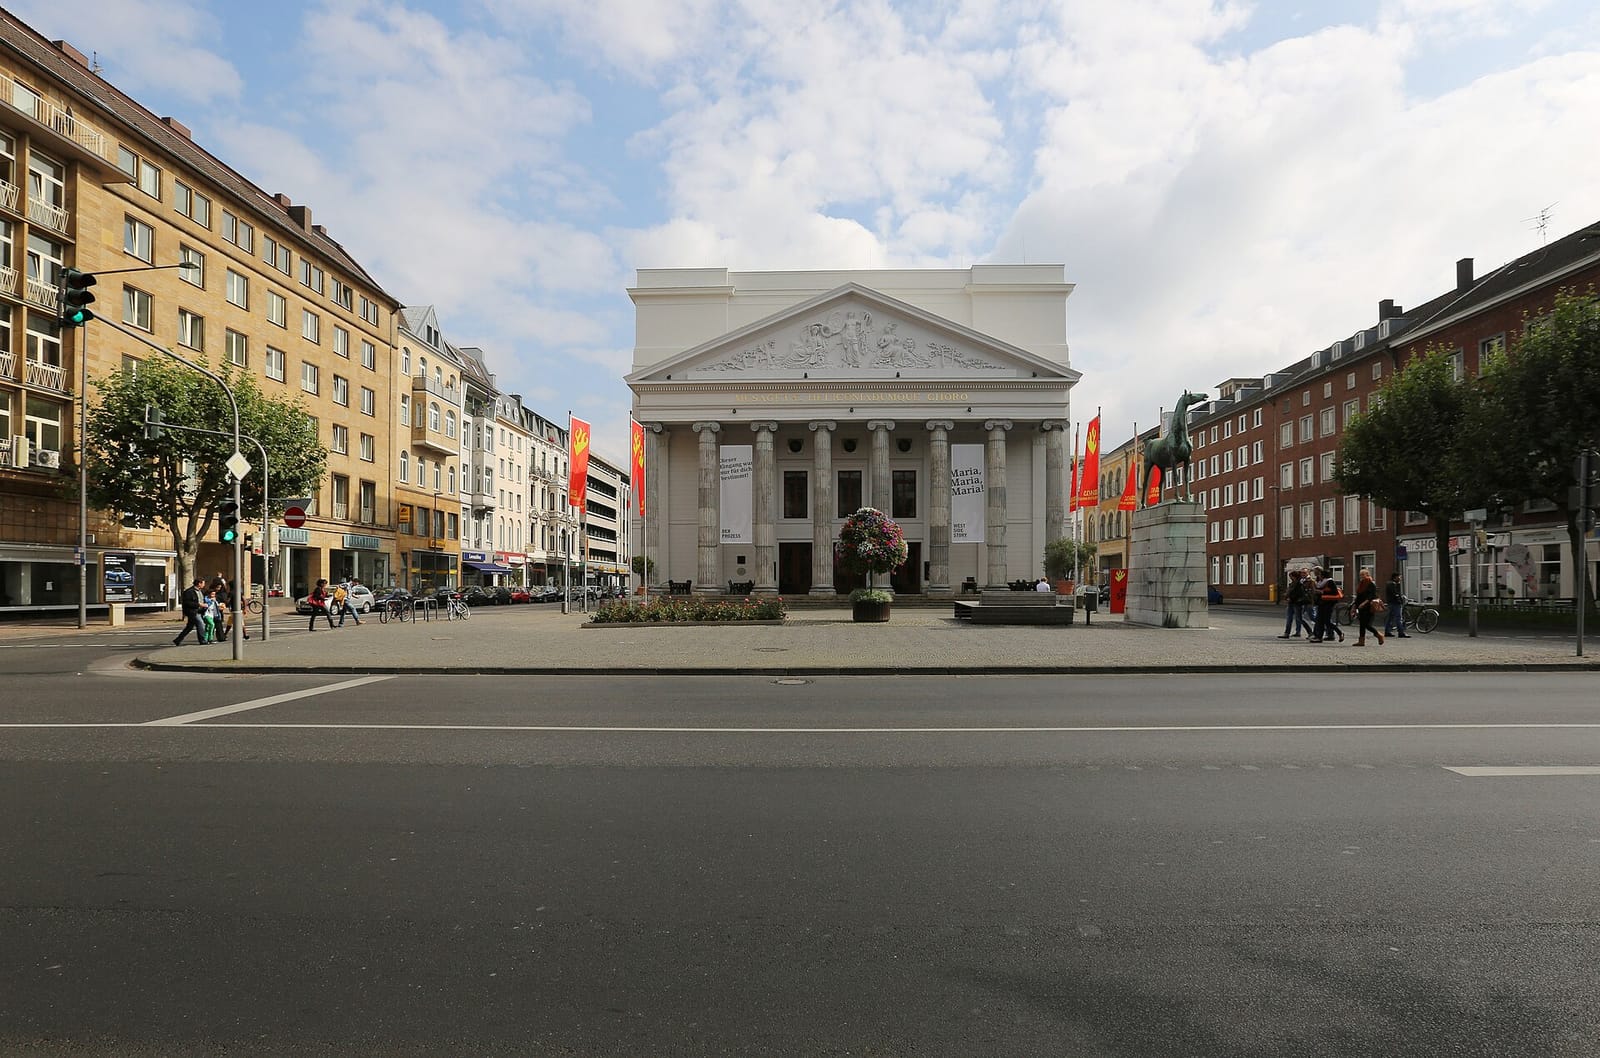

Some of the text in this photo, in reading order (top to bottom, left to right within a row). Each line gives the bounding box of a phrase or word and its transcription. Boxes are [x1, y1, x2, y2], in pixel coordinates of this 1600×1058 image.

[927, 392, 969, 401] CHORO
[951, 467, 982, 477] Maria,
[951, 476, 983, 486] Maria,
[951, 484, 984, 496] Maria!
